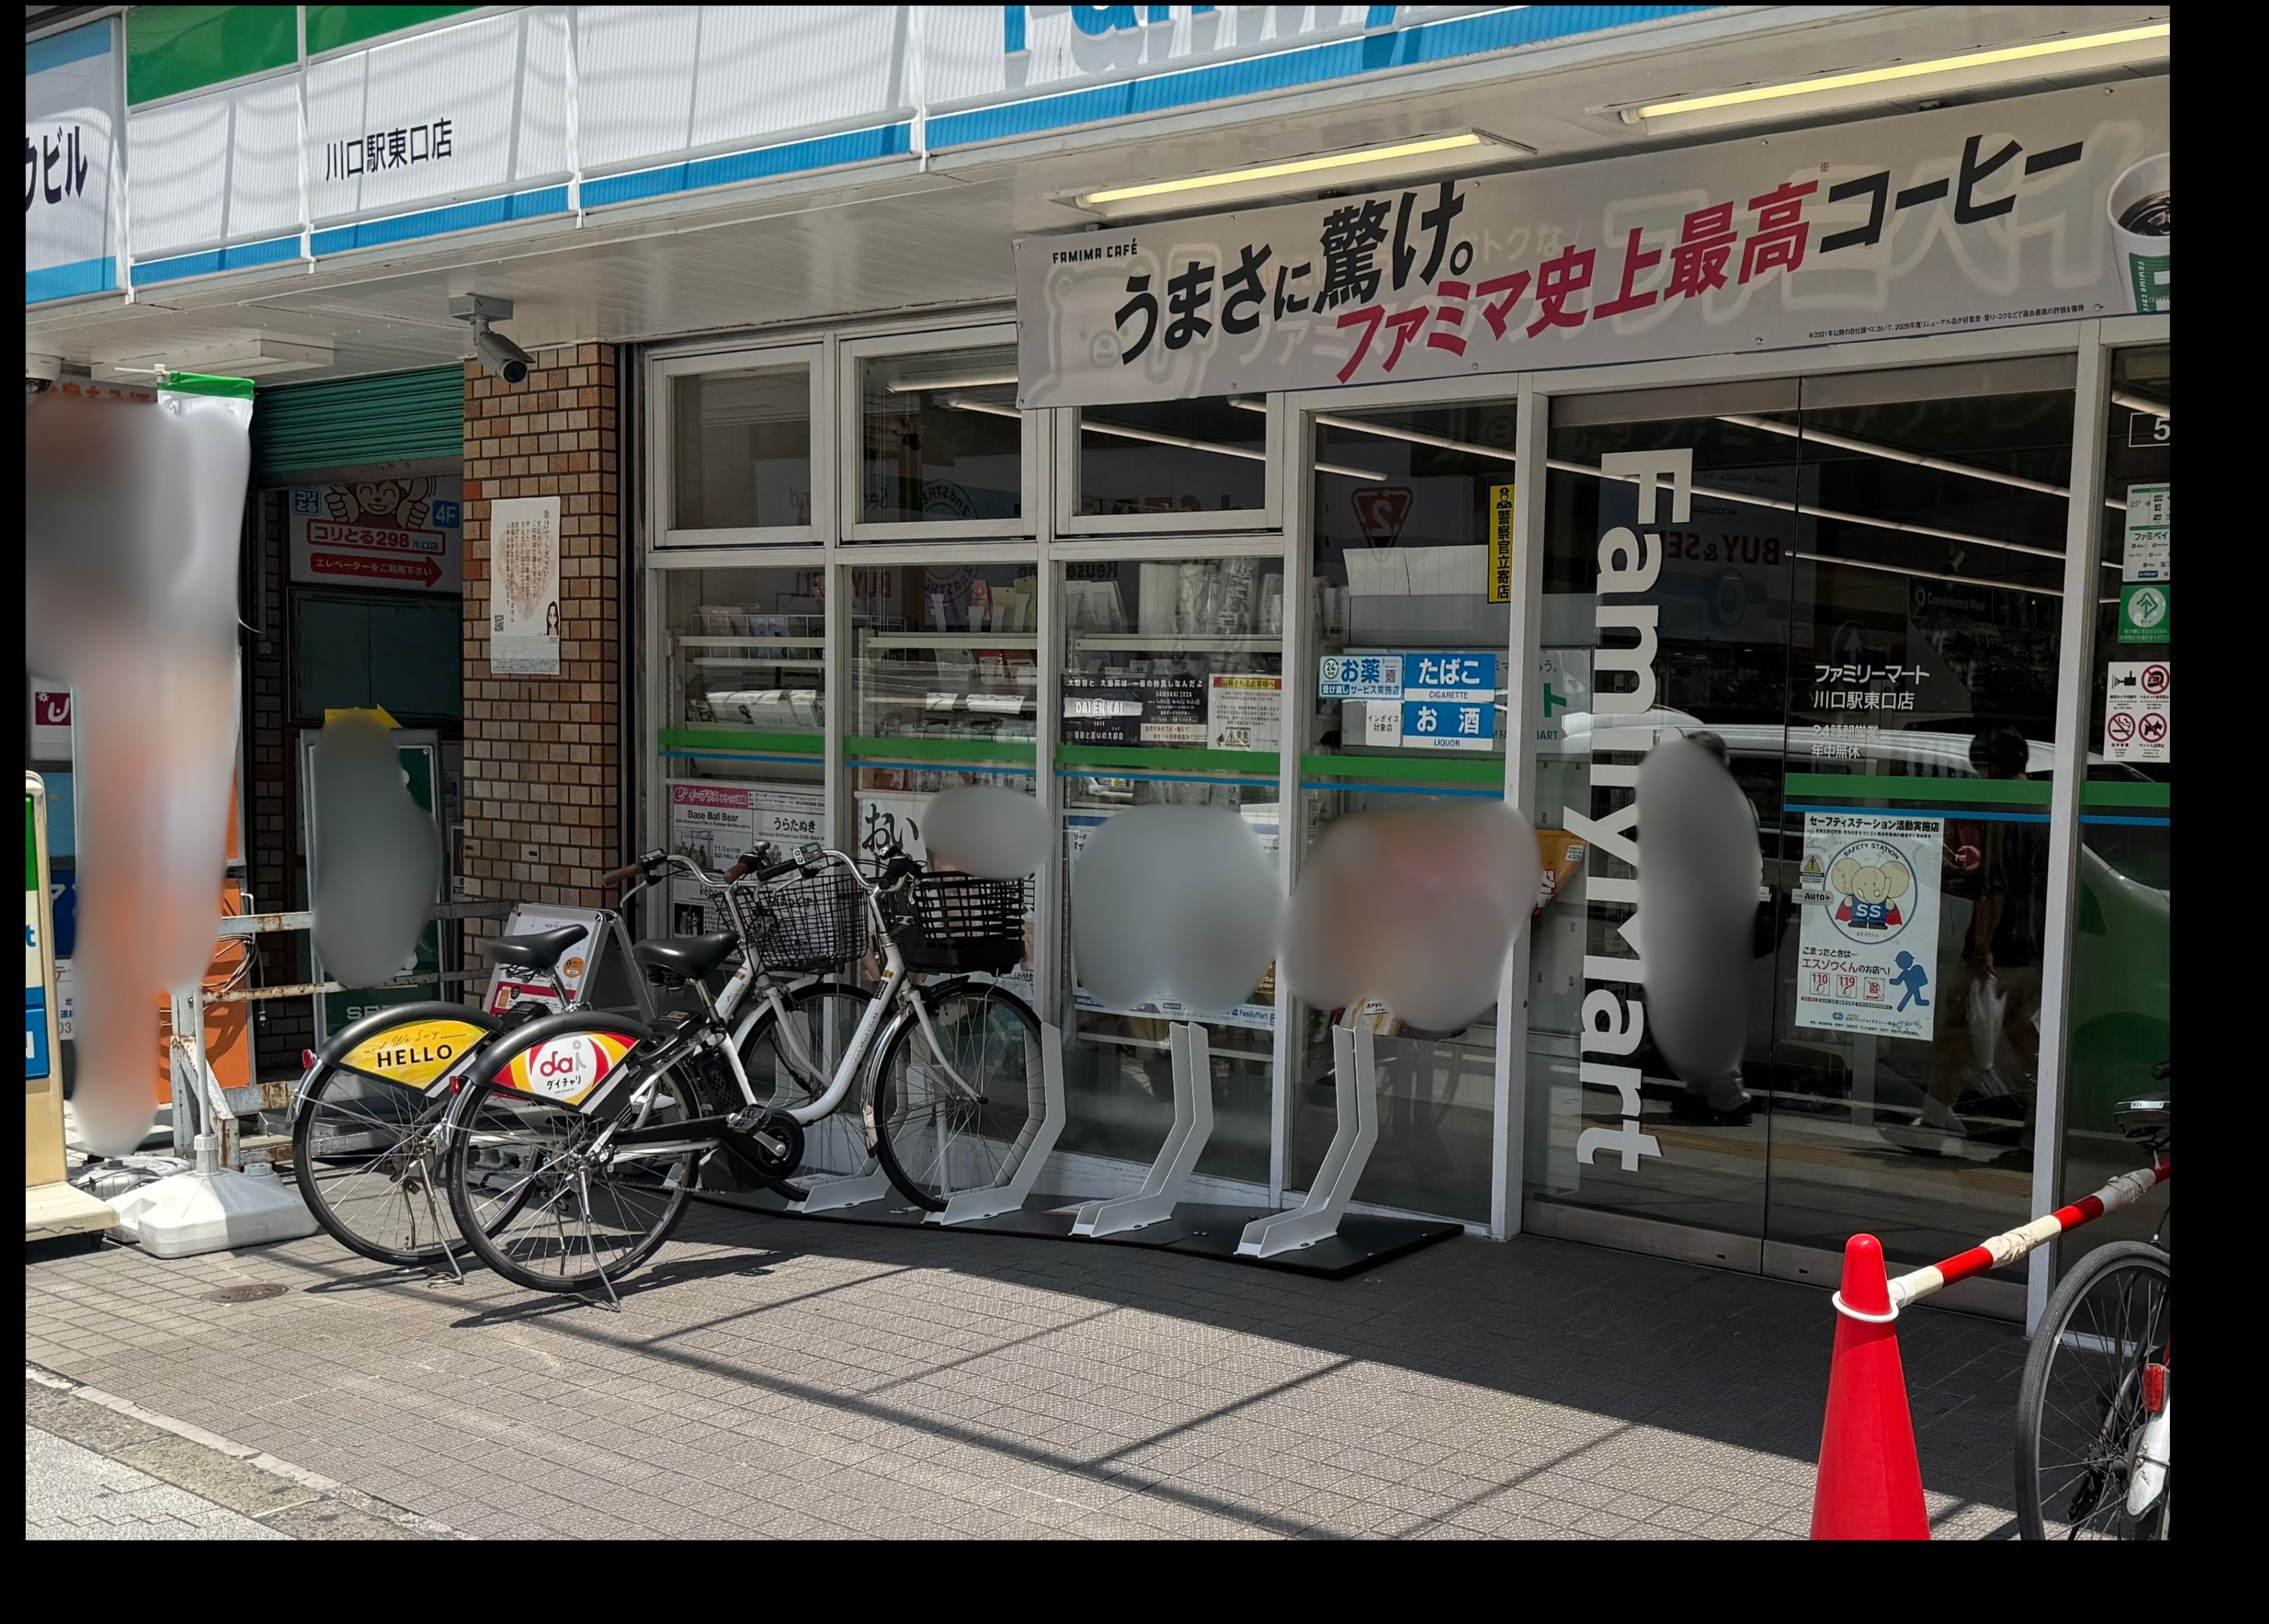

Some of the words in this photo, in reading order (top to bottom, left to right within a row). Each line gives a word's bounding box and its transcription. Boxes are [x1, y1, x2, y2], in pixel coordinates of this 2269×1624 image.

[325, 117, 452, 182] 川口駅東口店
[1052, 248, 1103, 264] FAMIMA
[1106, 237, 1138, 258] CAFÉ
[1115, 182, 1474, 366] うまさに驚け。
[436, 505, 458, 524] 4F
[315, 526, 410, 549] コリとる298
[2134, 531, 2169, 541] ファミペイ
[1497, 510, 1512, 599] 警察官立寄店
[316, 559, 432, 576] エレベーターをご利用下さい
[1326, 662, 1335, 671] 24
[1341, 658, 1380, 683] お薬
[1419, 658, 1480, 685] たばこ
[1814, 664, 1930, 685] ファミリーマート
[1429, 690, 1468, 700] CIGARETTE
[1813, 691, 1915, 711] 川口駅東口店
[1075, 701, 1123, 715] DAIENKAI
[1367, 715, 1399, 724] インボイス
[1373, 723, 1392, 732] 対象店
[1433, 739, 1460, 748] LIQUOR
[1811, 744, 1861, 759] 年中無休
[688, 810, 705, 819] Base
[707, 811, 721, 821] Ball
[722, 812, 739, 822] Bear
[1810, 816, 1940, 833] セーフティステーション活動実施店
[774, 816, 816, 834] うらたぬき
[1843, 843, 1869, 857] SAFETY
[1871, 843, 1899, 860] STATION
[1804, 892, 1825, 902] Auto
[1811, 974, 1828, 985] 110
[1839, 976, 1855, 987] 119
[1239, 1009, 1269, 1020] FamilyMart
[377, 1044, 453, 1068] HELLO
[547, 1074, 581, 1091] ダイチャリ
